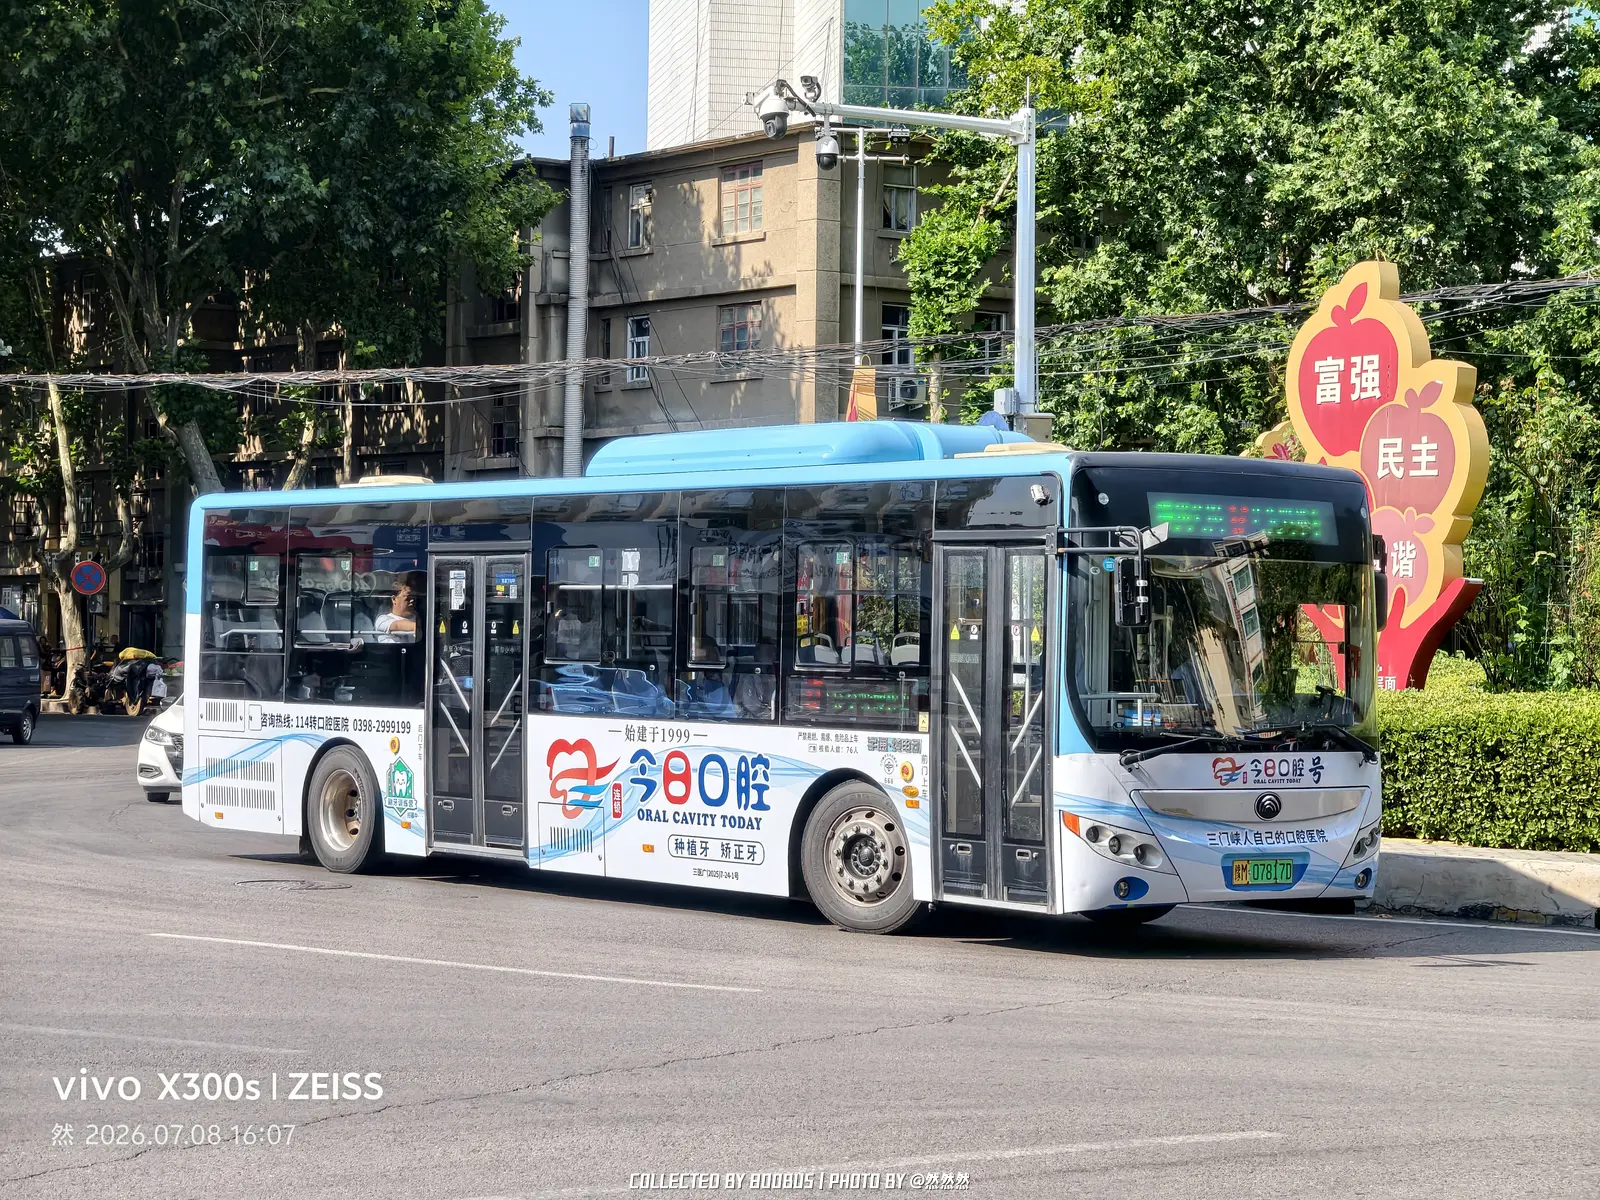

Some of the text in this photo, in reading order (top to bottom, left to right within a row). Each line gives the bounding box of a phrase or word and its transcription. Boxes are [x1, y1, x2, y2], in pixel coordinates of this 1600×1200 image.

[1314, 355, 1381, 405] 富强
[1376, 435, 1439, 479] 民主
[352, 718, 411, 734] 0398-2999199
[630, 748, 771, 811] 今日口腔
[637, 808, 763, 831] ORAL CAVITY TODAY
[1206, 828, 1329, 847] 三门峡人自己的口腔医院
[674, 838, 758, 863] 种植牙 矫正牙
